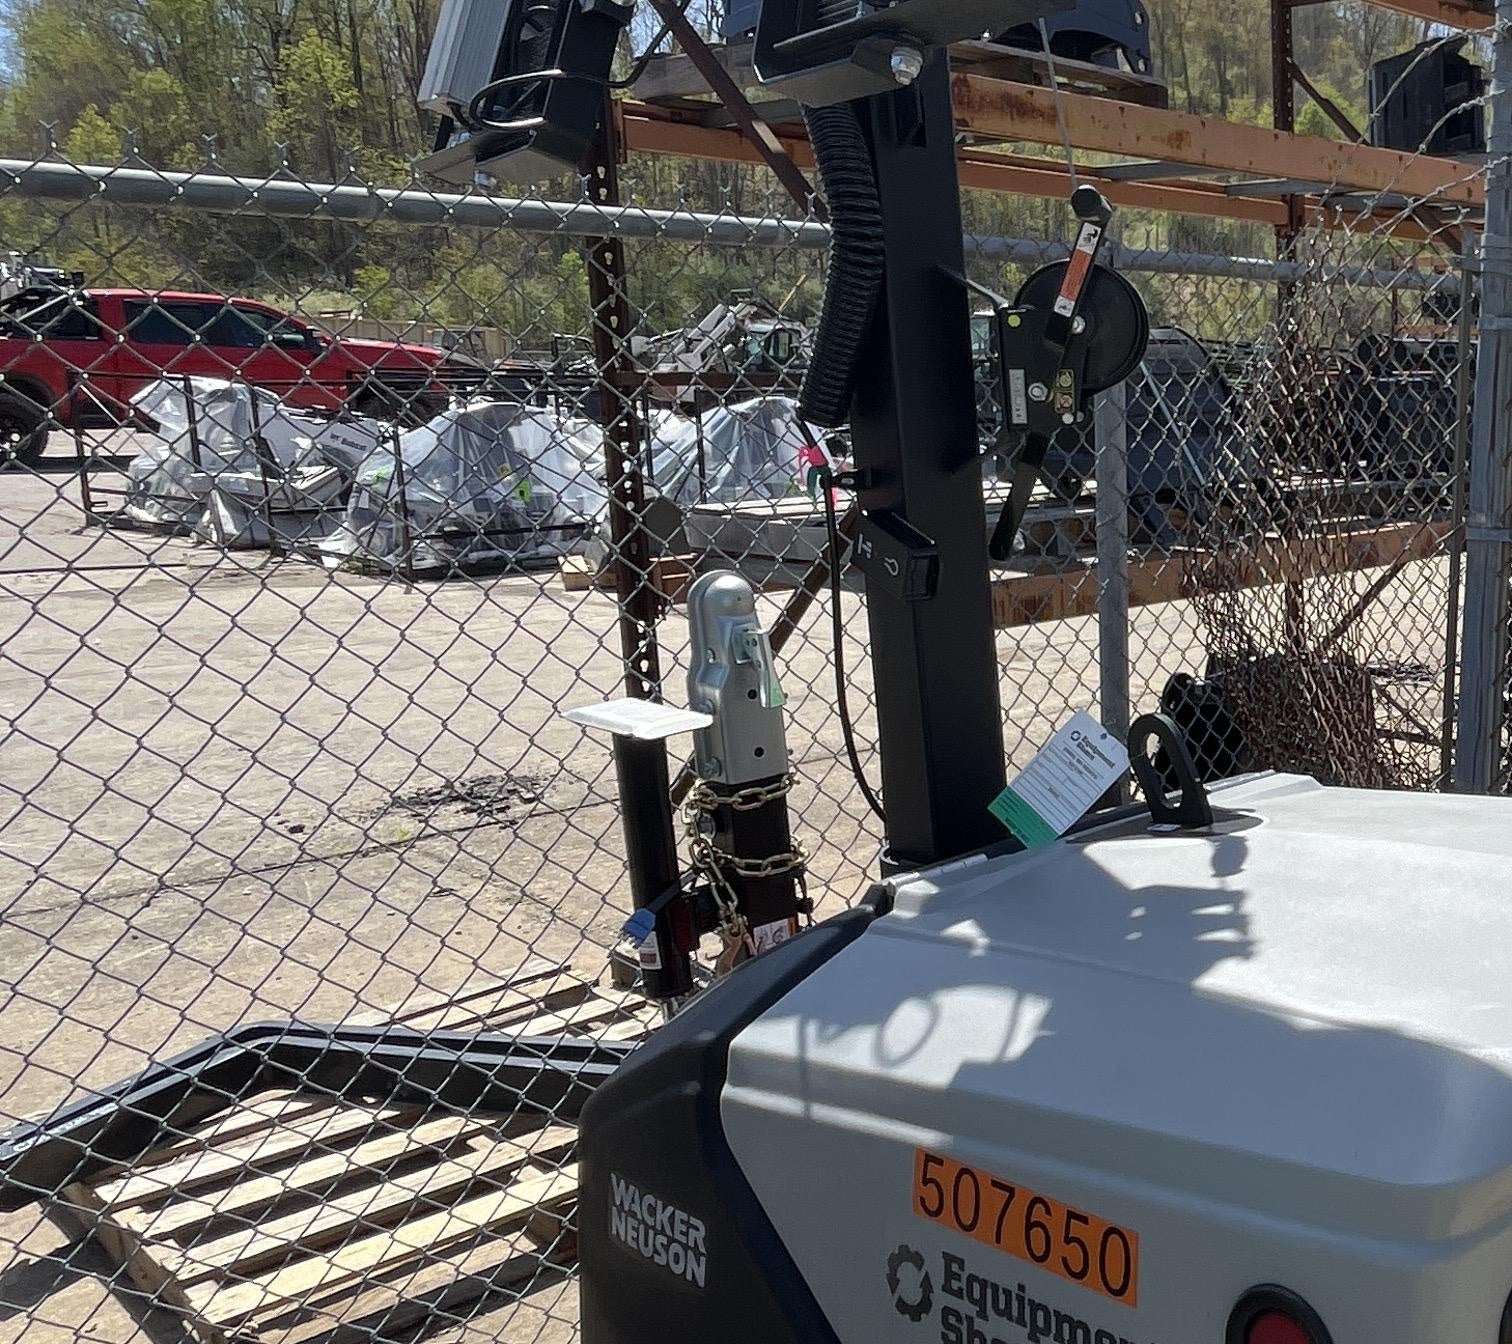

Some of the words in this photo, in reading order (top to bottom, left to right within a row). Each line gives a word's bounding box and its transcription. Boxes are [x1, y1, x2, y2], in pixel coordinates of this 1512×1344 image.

[610, 1172, 707, 1255] WACKER
[611, 1205, 706, 1288] NEUSON
[919, 1156, 1132, 1298] 507650
